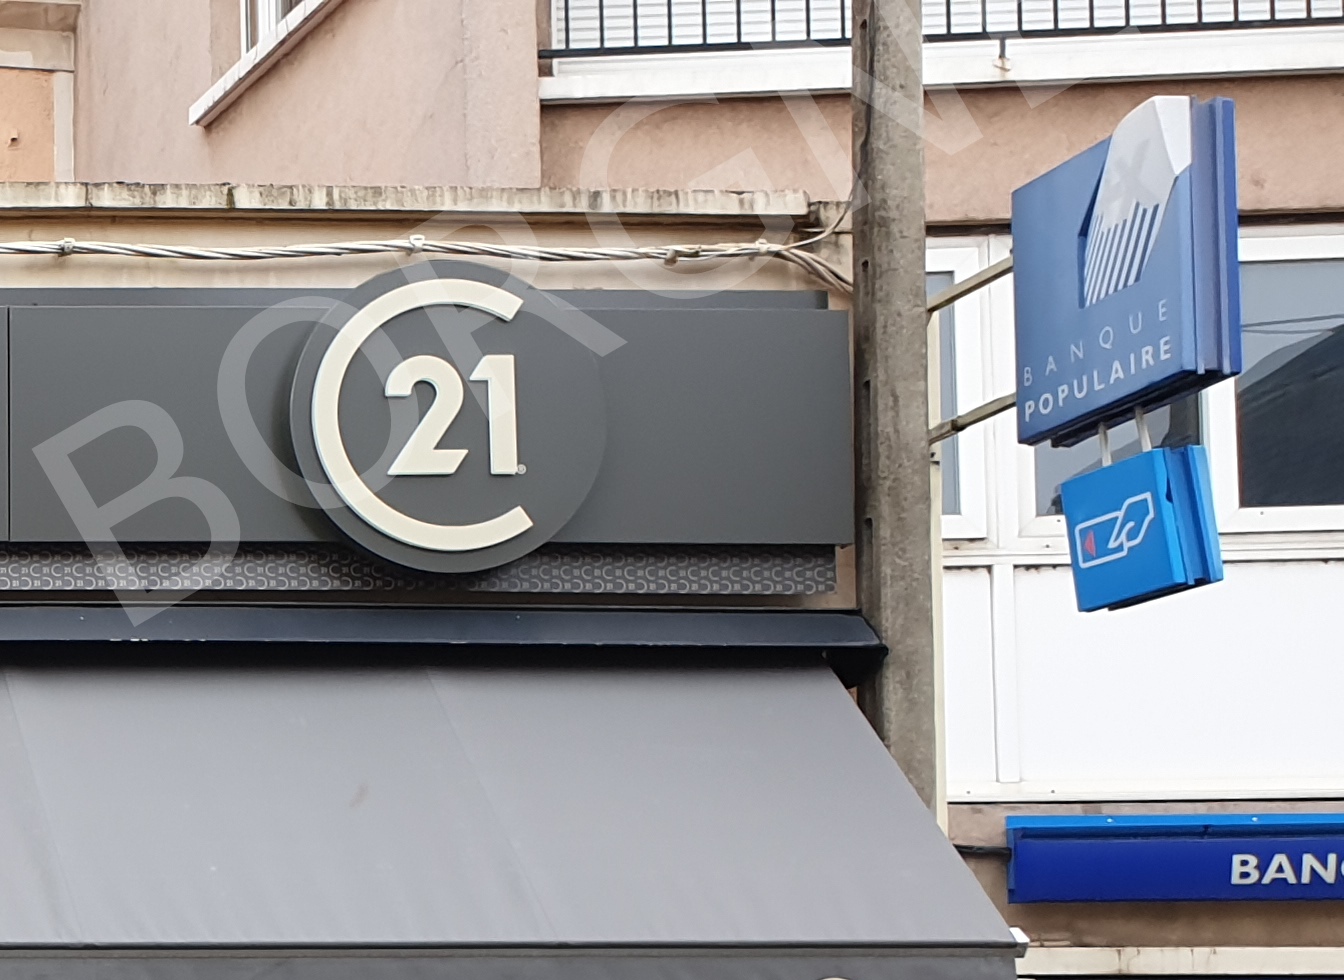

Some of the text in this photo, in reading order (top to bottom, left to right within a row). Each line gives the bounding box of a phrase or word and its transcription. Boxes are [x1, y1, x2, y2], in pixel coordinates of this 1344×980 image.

[1023, 299, 1168, 387] BANQUE
[1025, 336, 1172, 423] POPULAIRE
[1231, 853, 1344, 886] BAN
